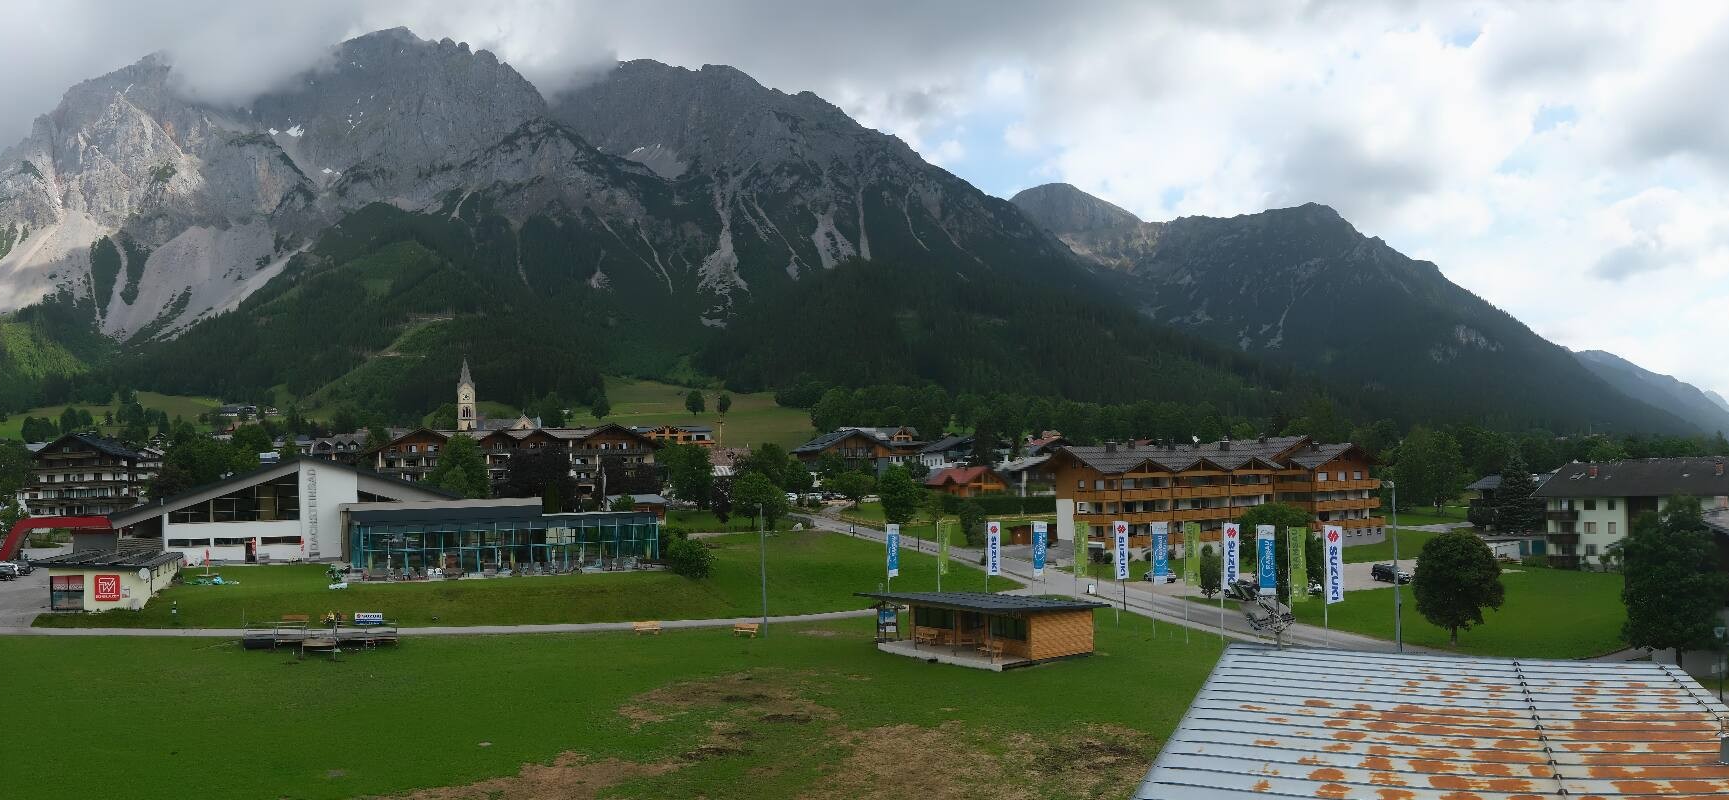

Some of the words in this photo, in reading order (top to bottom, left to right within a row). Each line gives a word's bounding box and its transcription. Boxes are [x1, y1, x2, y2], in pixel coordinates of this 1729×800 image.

[307, 468, 319, 551] DACHSTEINBAD
[990, 535, 998, 573] SUZUKI
[1329, 545, 1339, 601] SUZUKI
